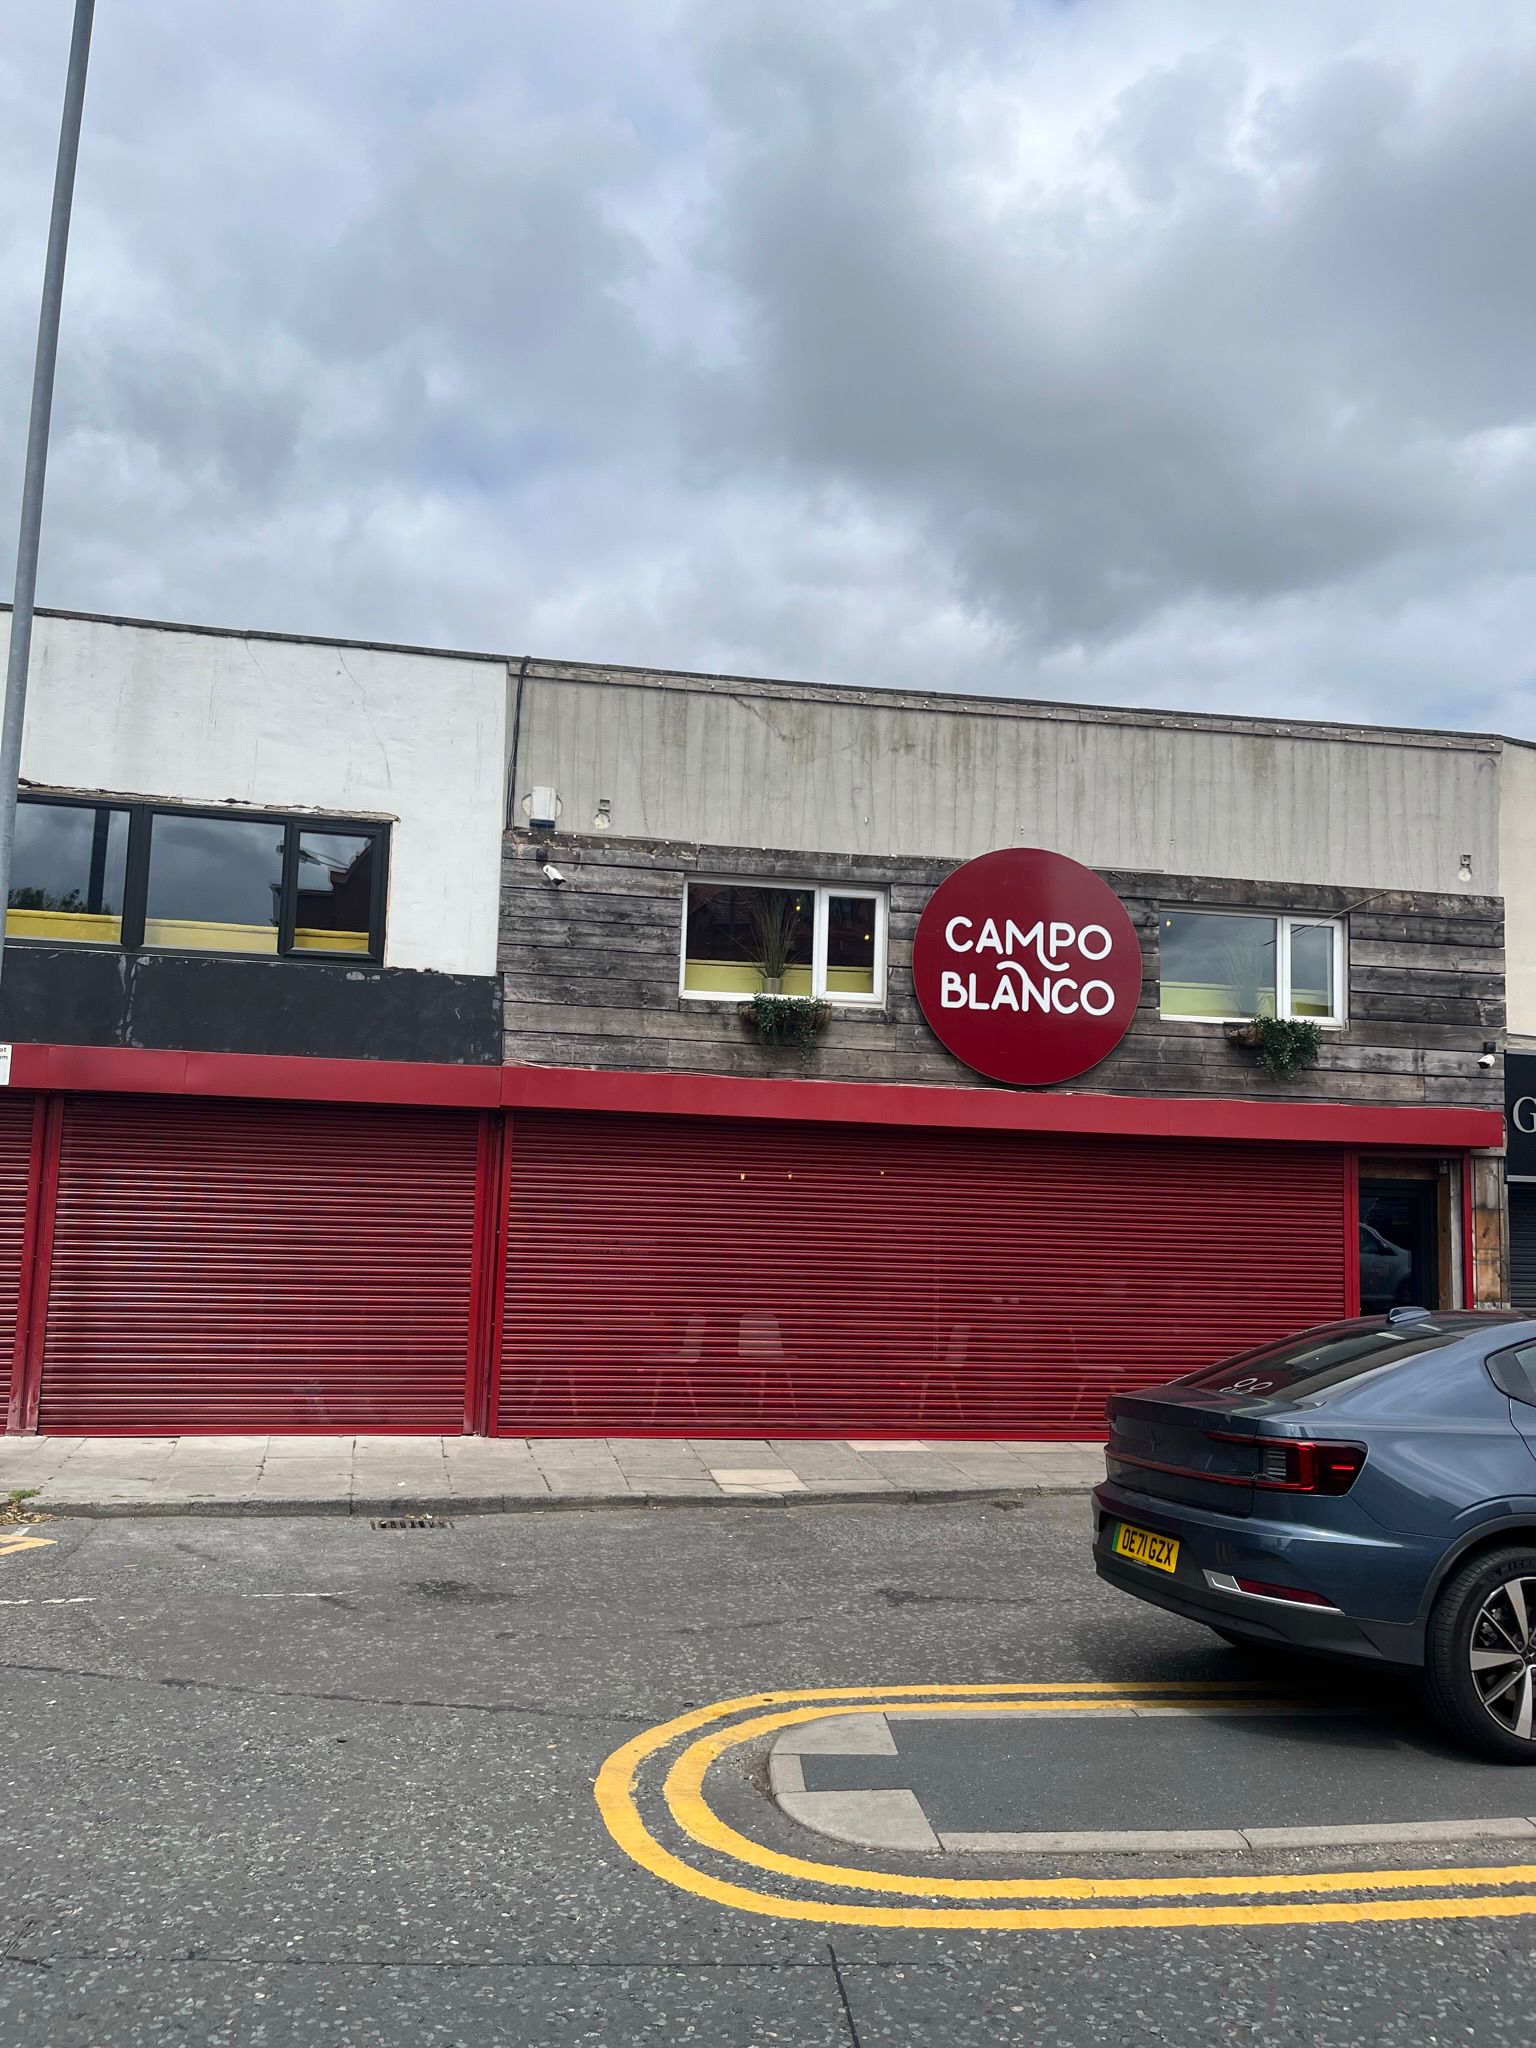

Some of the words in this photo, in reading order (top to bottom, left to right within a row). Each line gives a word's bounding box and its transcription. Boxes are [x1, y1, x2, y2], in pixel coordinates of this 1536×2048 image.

[945, 916, 1112, 972] CAMPO
[941, 961, 1115, 1016] BLANCO
[1149, 1537, 1174, 1566] GZX
